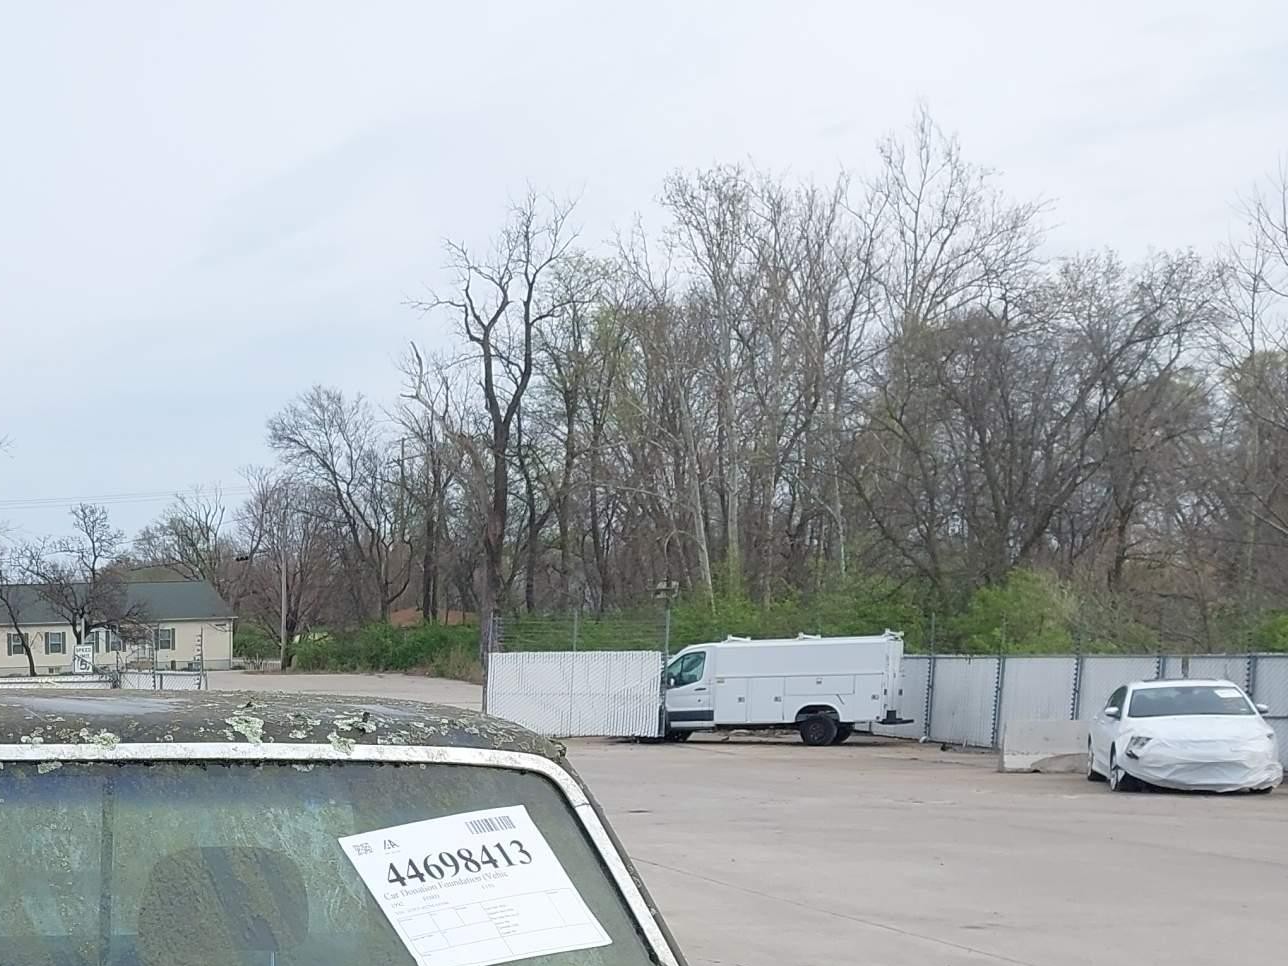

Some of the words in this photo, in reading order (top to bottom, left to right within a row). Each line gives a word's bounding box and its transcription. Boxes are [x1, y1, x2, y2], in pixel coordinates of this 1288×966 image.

[387, 839, 532, 887] 44698413
[399, 884, 438, 897] Donation
[437, 876, 481, 889] Foundation
